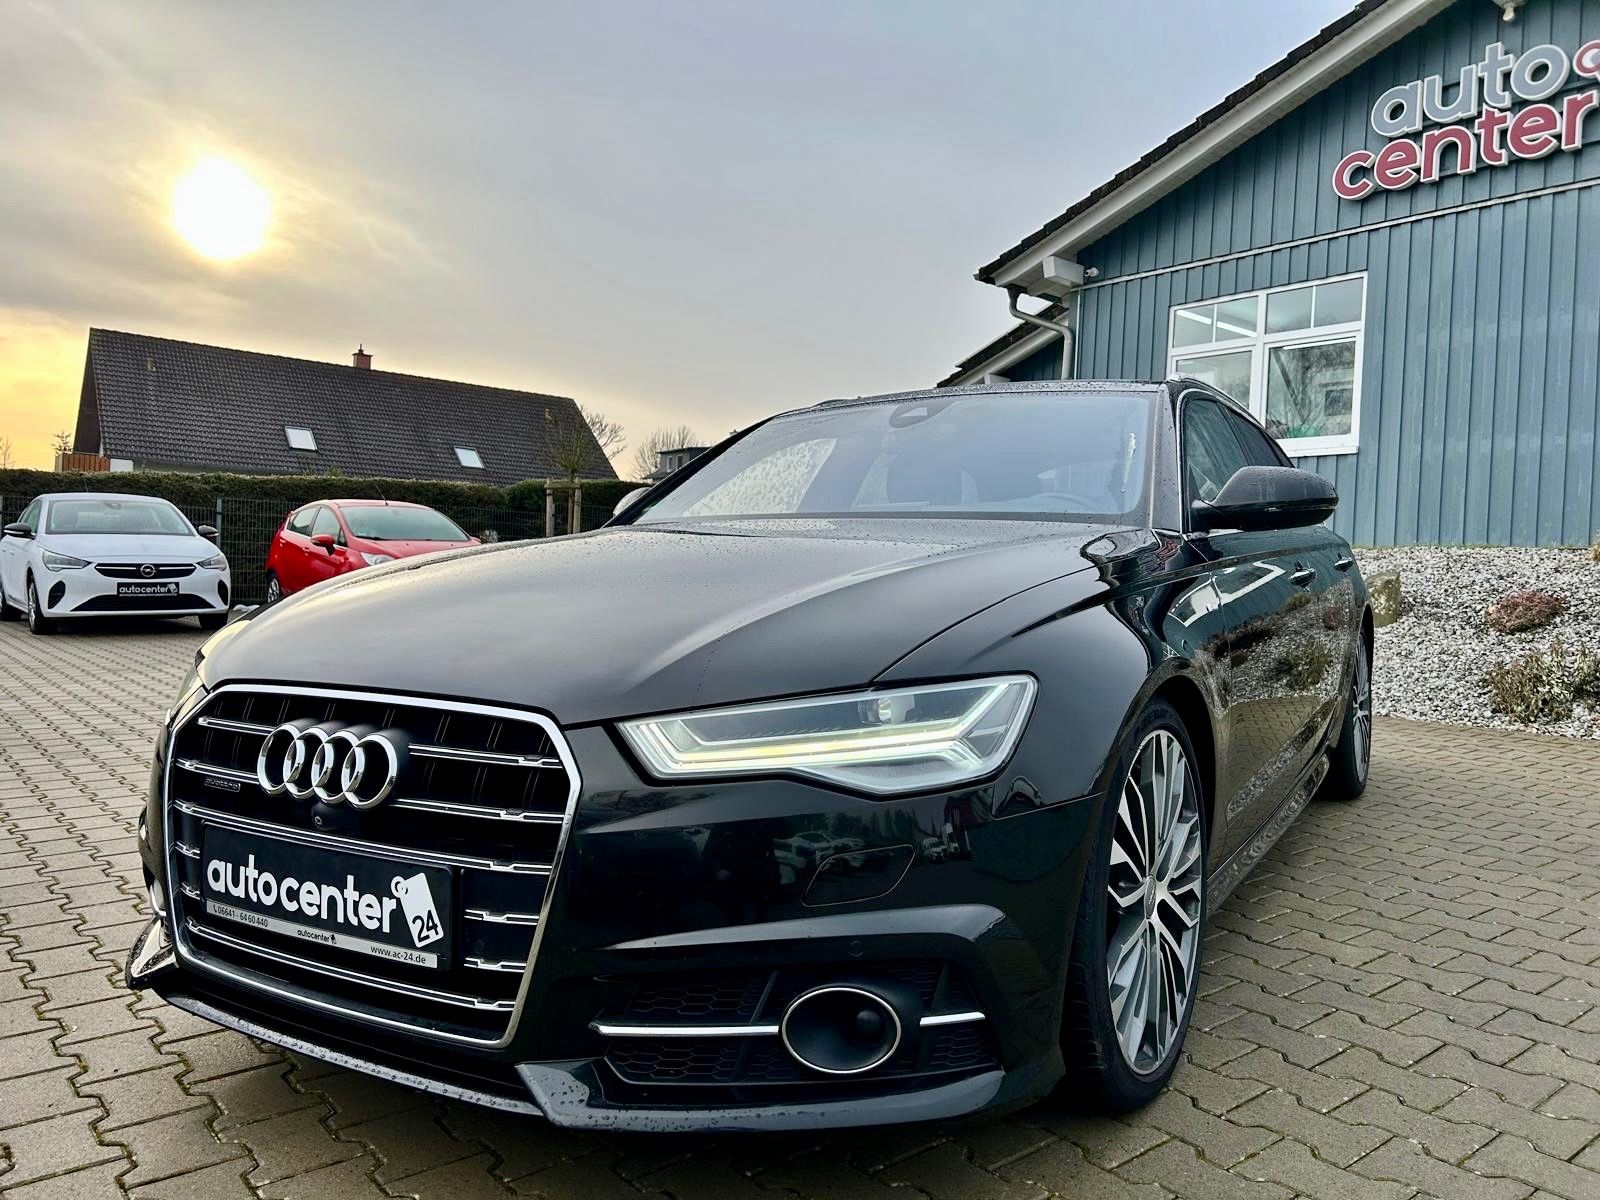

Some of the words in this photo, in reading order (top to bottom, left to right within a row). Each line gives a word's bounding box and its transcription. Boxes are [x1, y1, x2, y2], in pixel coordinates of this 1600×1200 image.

[1371, 42, 1570, 137] auto
[1332, 90, 1599, 200] center
[119, 585, 168, 593] autocenter
[207, 854, 396, 933] autocenter
[297, 929, 330, 943] autocenter
[412, 909, 438, 943] 24
[371, 946, 426, 965] www.ac-24.de
